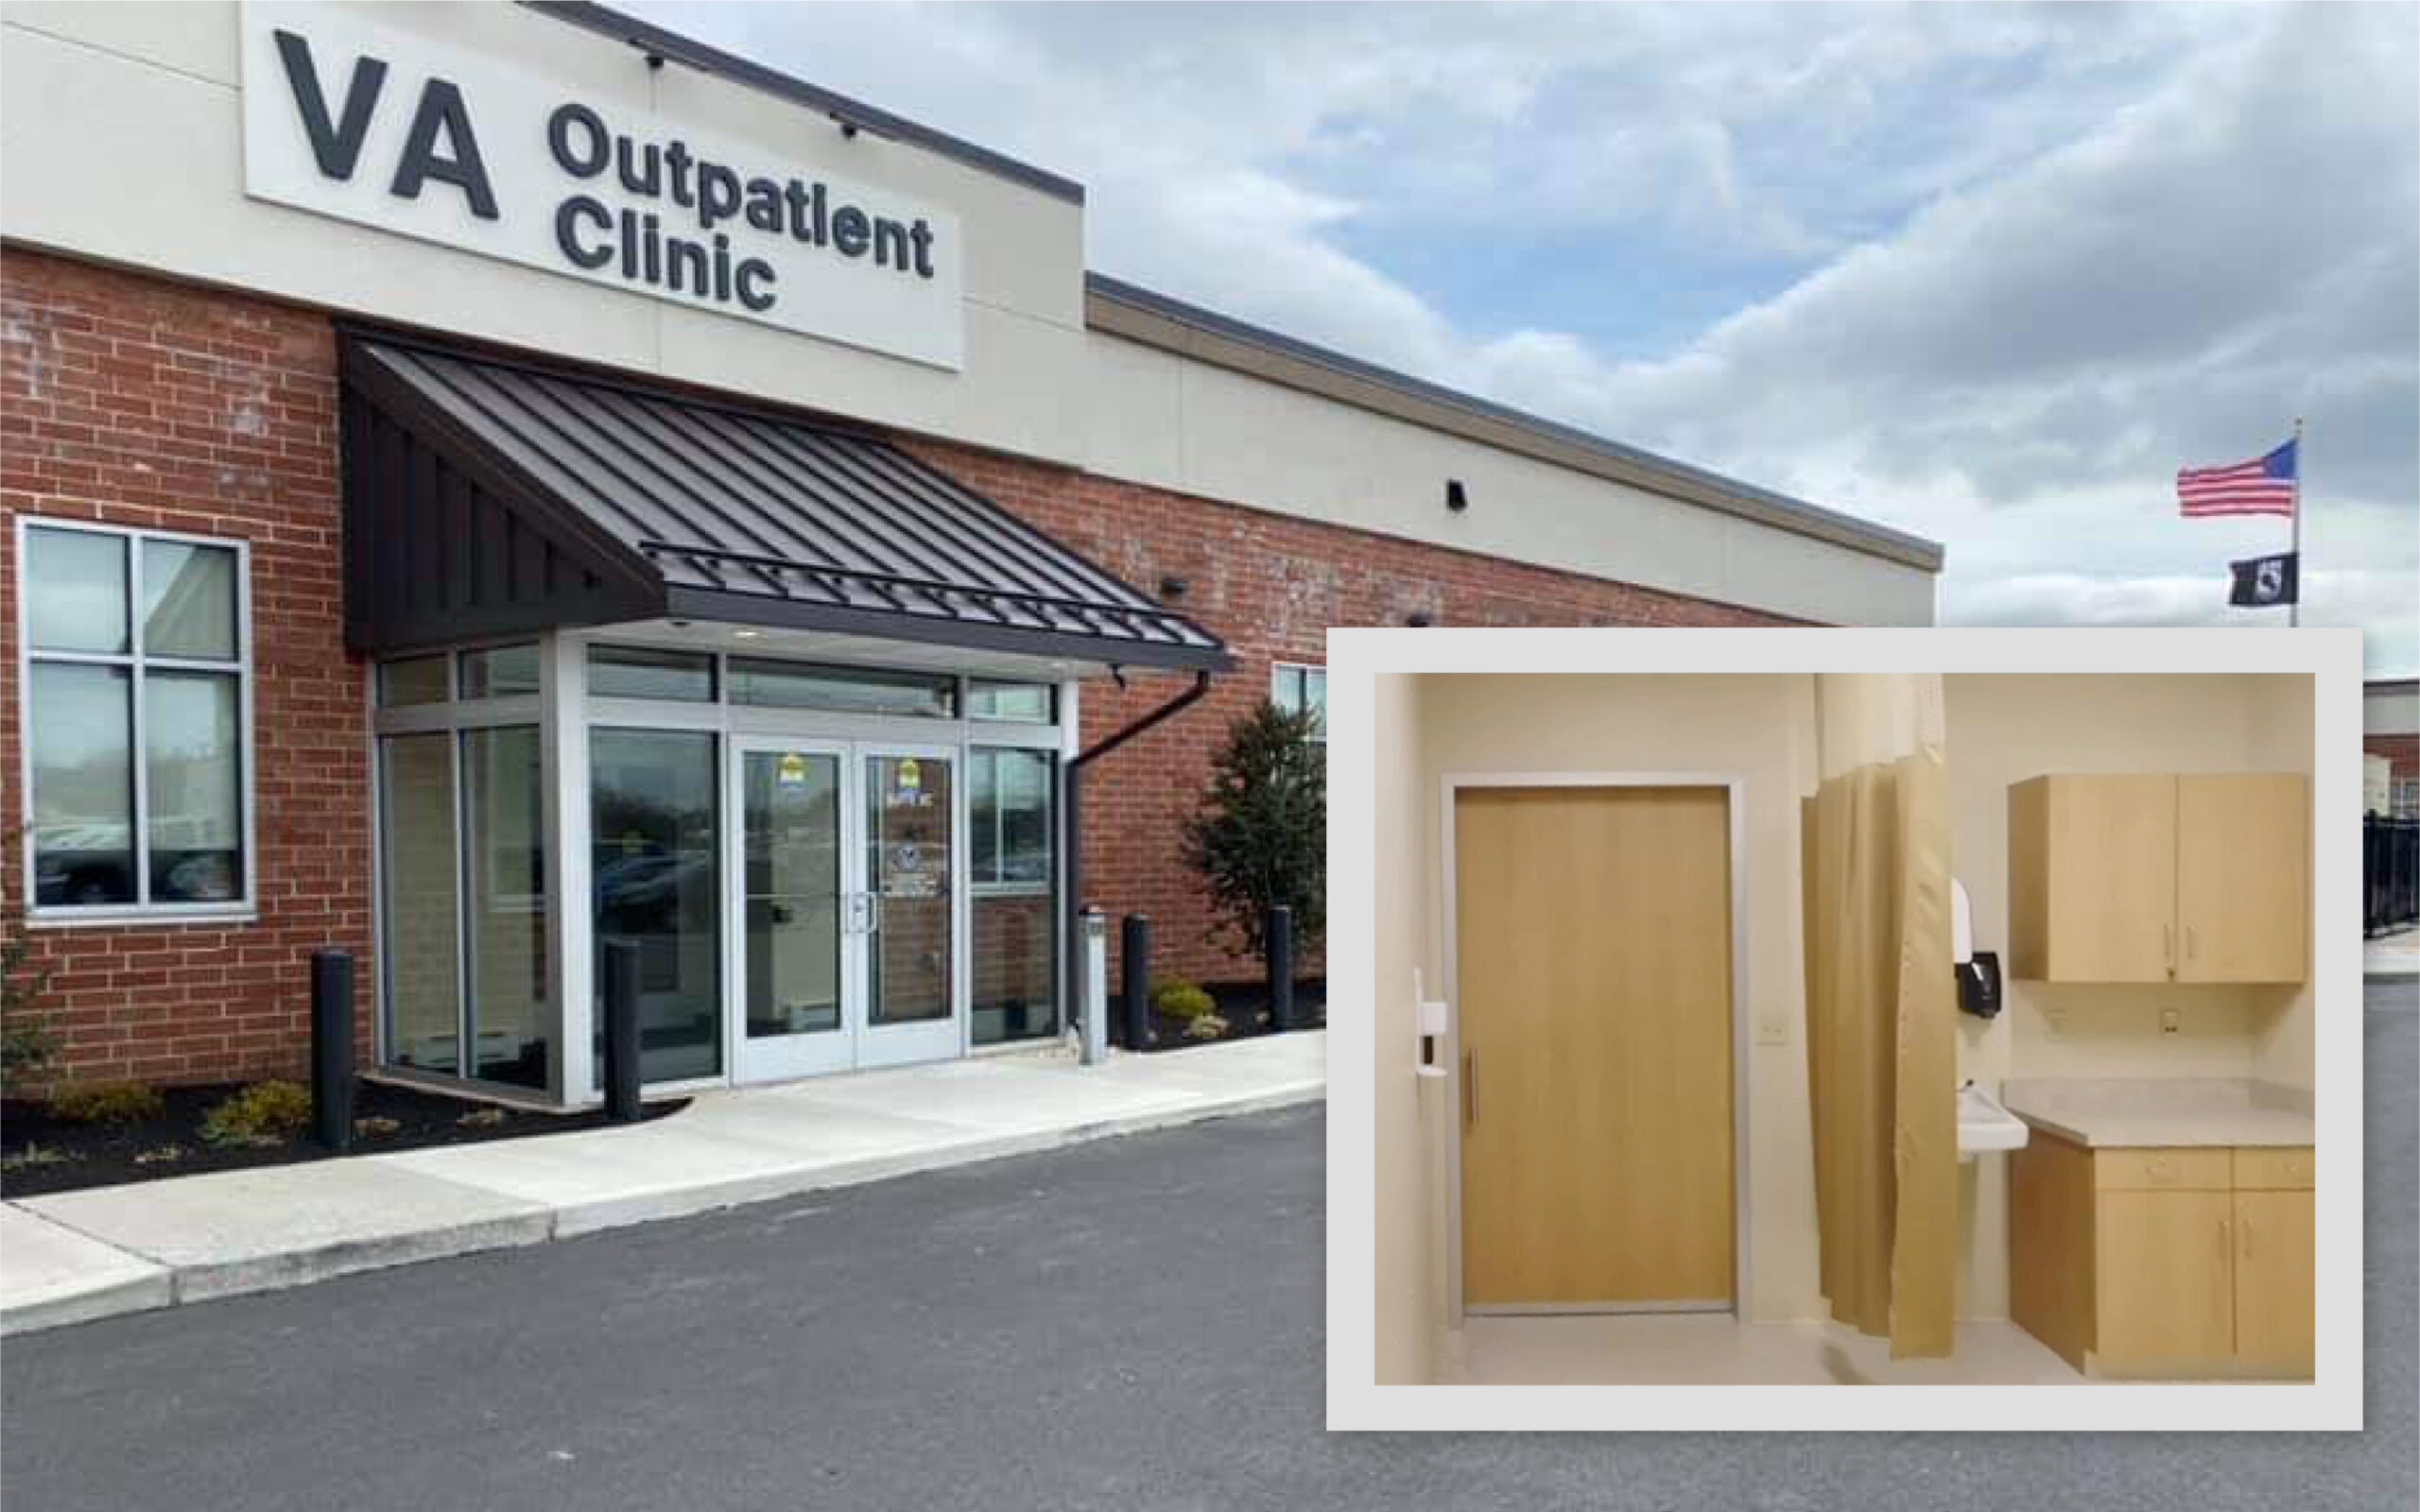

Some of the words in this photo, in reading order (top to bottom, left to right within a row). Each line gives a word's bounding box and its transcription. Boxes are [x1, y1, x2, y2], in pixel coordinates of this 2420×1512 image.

[272, 28, 499, 221] VA
[546, 103, 934, 280] Outpatient
[554, 195, 776, 313] Clinic
